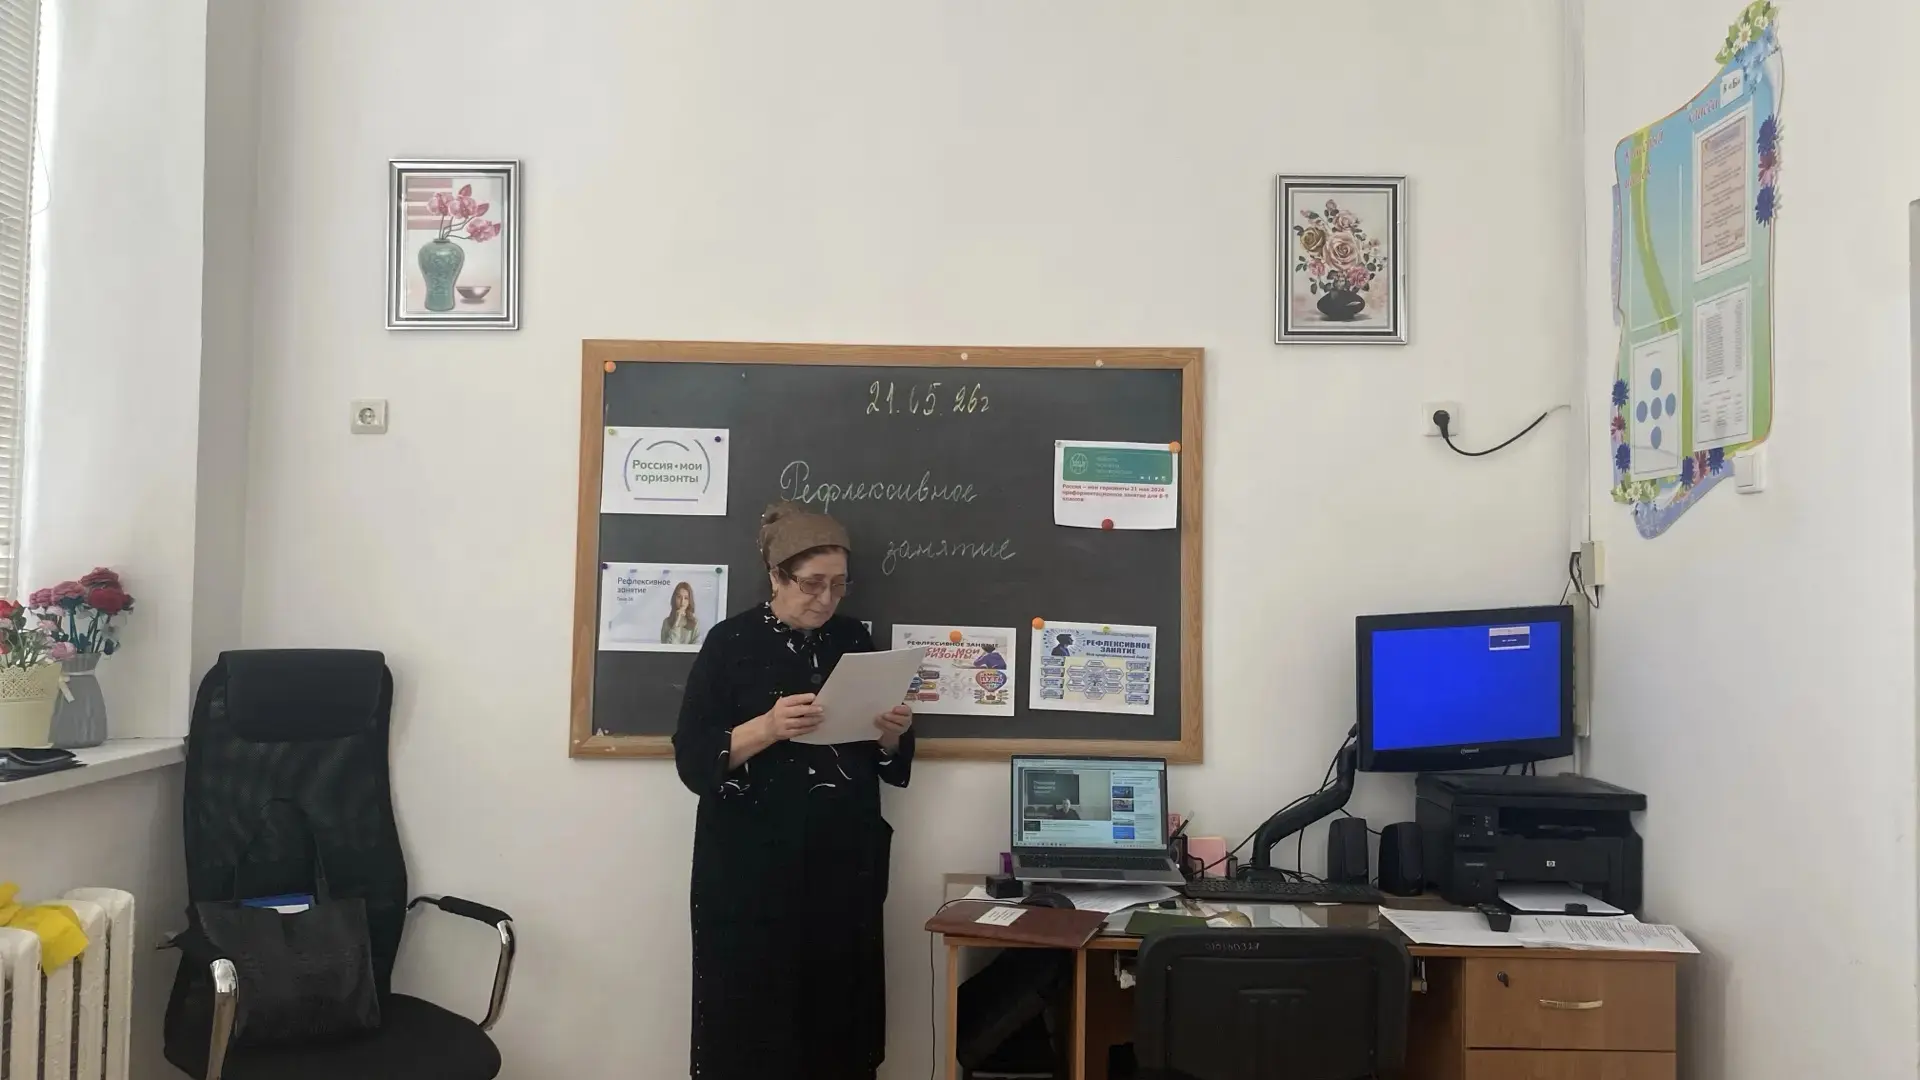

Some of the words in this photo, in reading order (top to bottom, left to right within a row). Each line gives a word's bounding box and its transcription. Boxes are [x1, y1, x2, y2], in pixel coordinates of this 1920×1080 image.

[632, 459, 673, 471] Россия
[679, 462, 702, 471] мои
[635, 473, 699, 485] горизонты
[780, 460, 978, 514] Рефлексивное
[882, 539, 1016, 575] занятие
[617, 577, 671, 587] Рефлексивное
[1086, 639, 1151, 650] РЕФЛЕКСИВНОЕ
[956, 648, 980, 656] МОИ
[1100, 647, 1136, 655] ЗАНЯТИЕ
